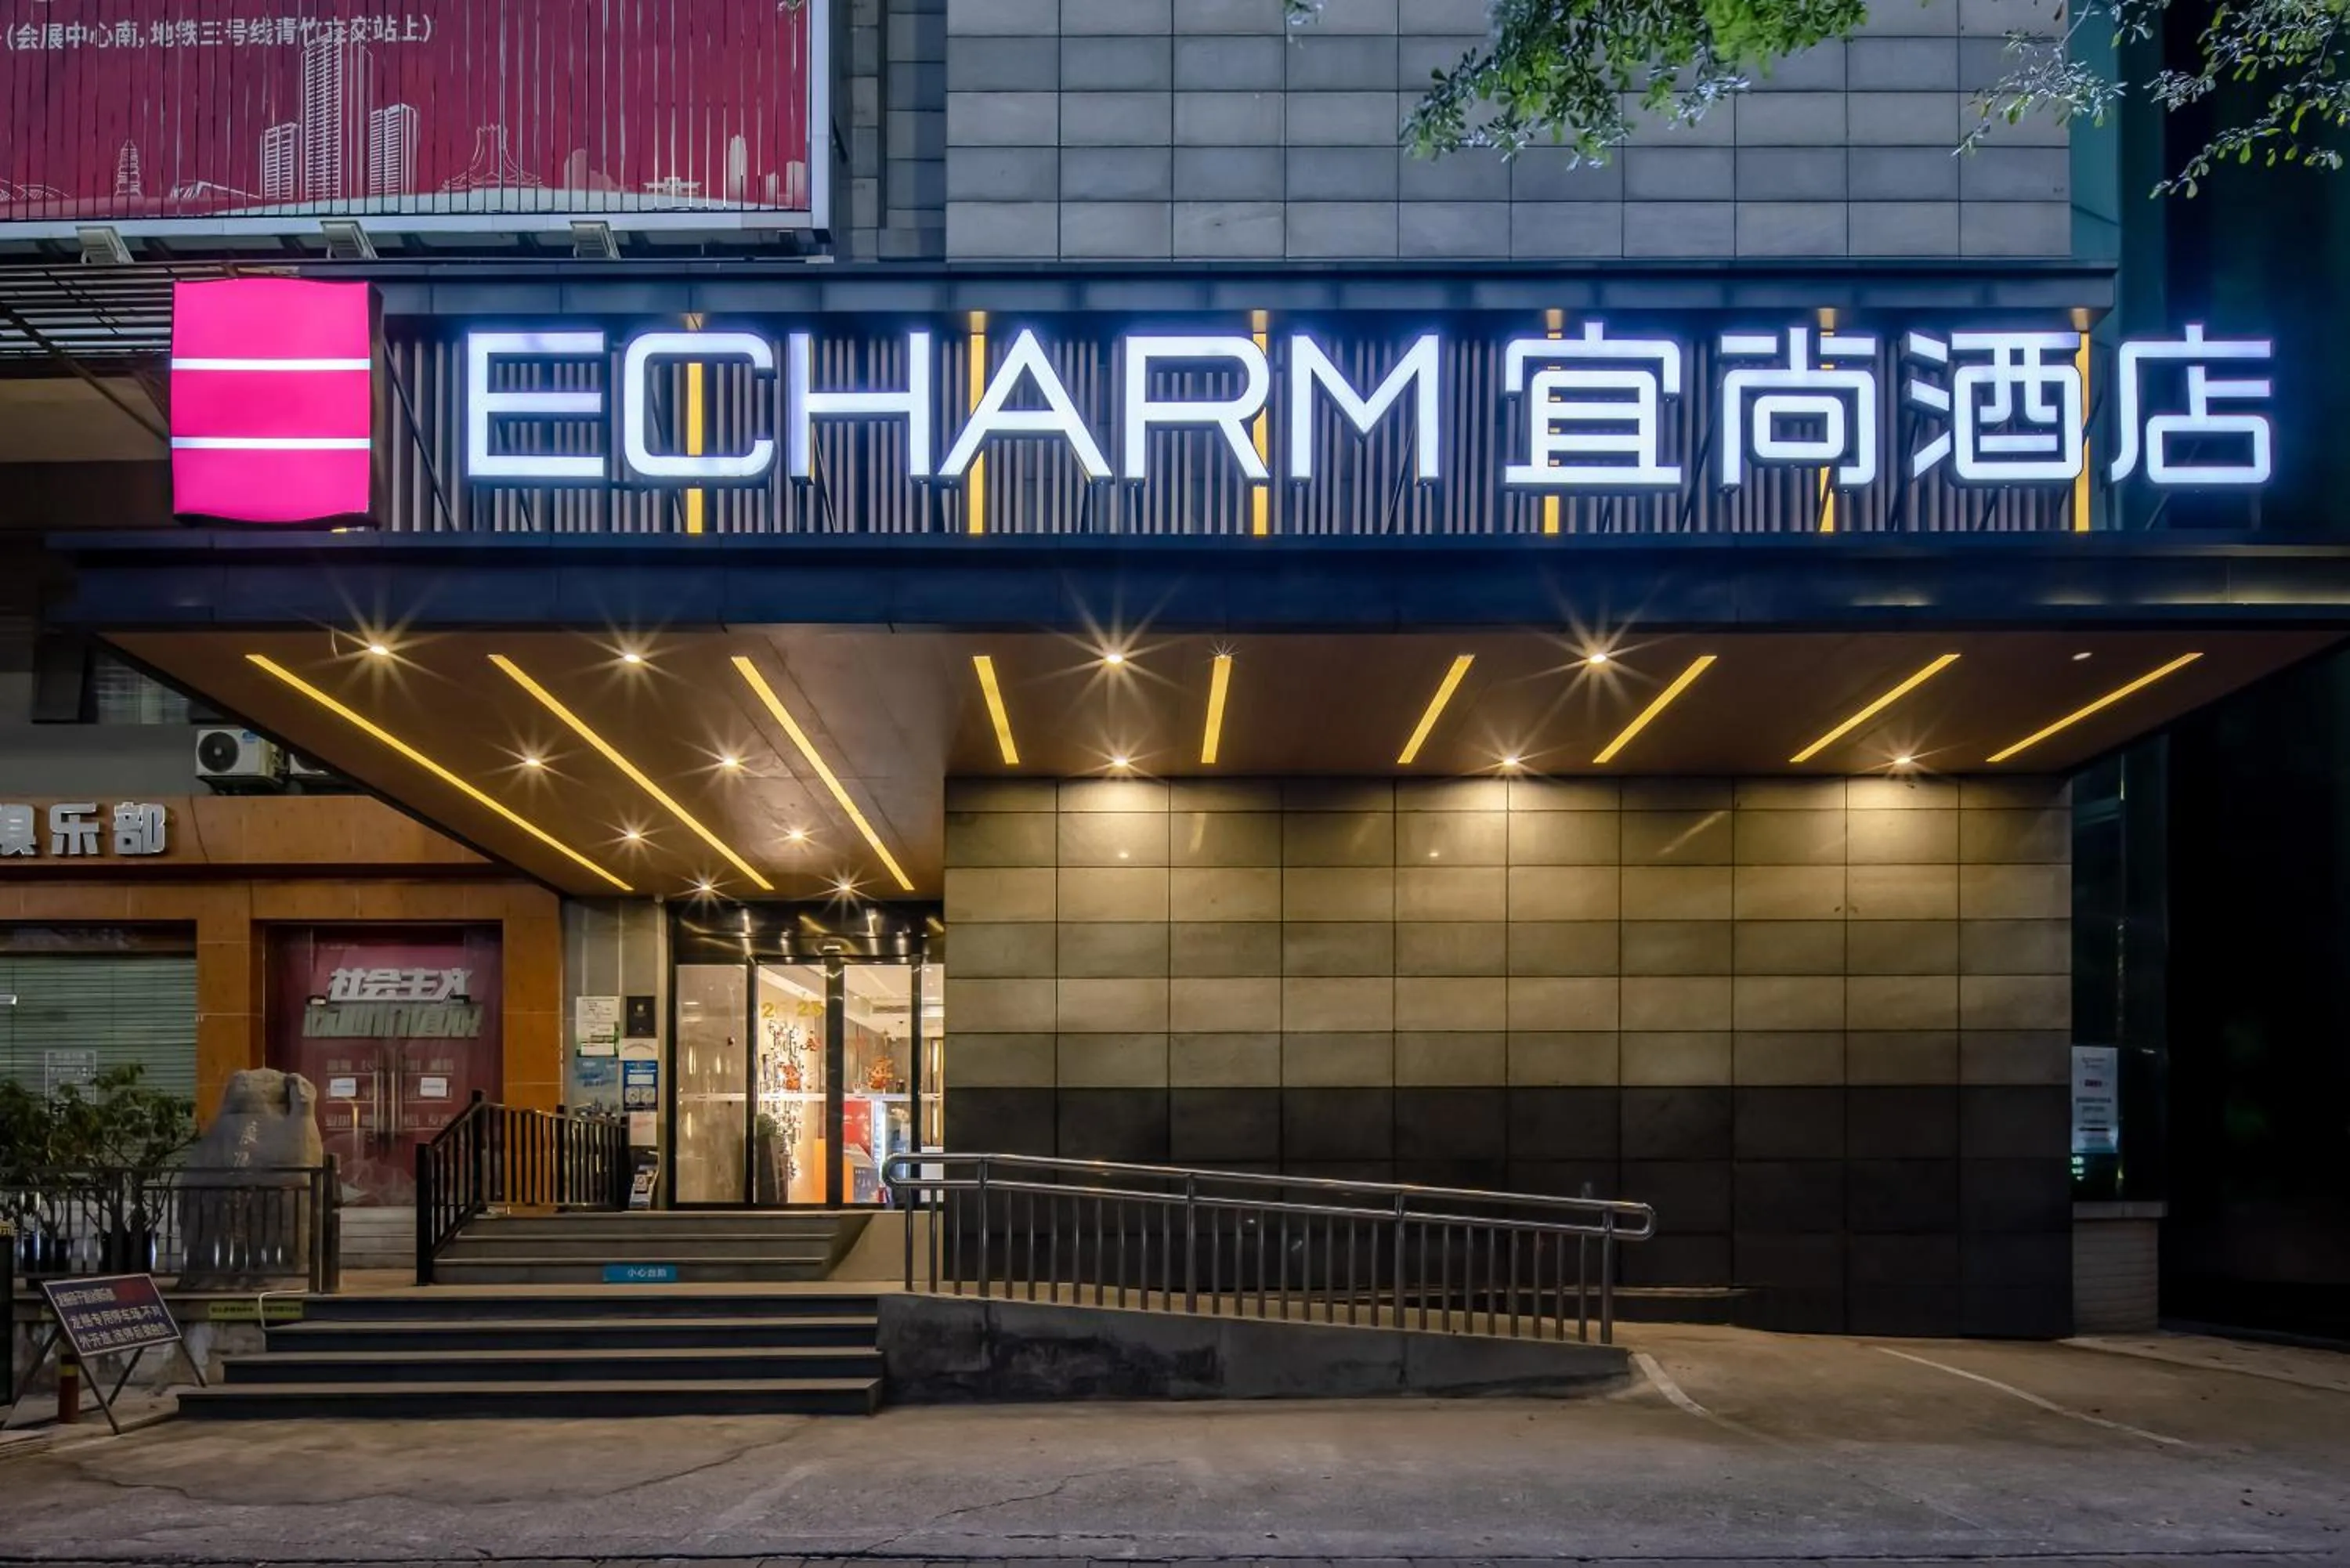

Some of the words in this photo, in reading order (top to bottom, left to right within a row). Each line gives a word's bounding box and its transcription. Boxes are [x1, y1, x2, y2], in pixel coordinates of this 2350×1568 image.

[468, 329, 1440, 481] ECHARM
[1505, 322, 2272, 486] 宜尚酒店
[0, 801, 166, 855] 俱乐部
[327, 967, 472, 1003] 社会主义
